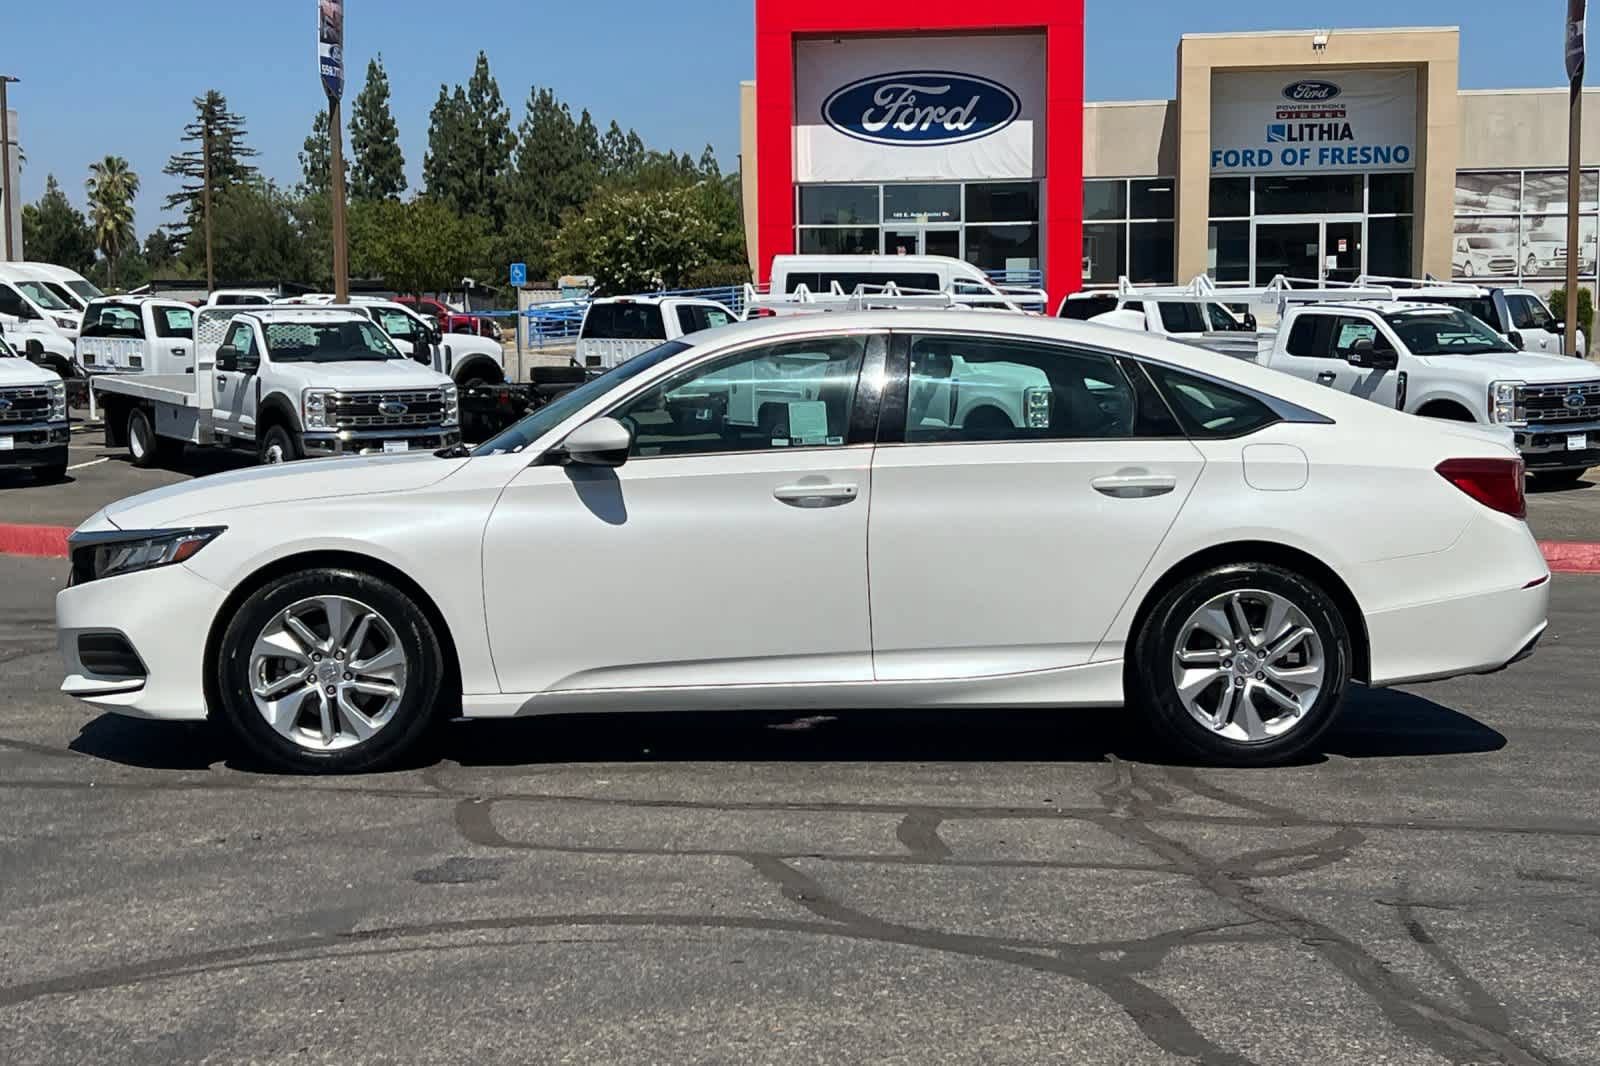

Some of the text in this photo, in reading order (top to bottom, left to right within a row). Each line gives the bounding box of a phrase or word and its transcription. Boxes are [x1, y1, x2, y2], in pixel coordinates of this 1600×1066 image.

[1293, 83, 1329, 98] Ford
[862, 83, 980, 132] Ford
[1287, 123, 1354, 141] LITHIA
[1211, 145, 1410, 168] FORD OF FRESNO
